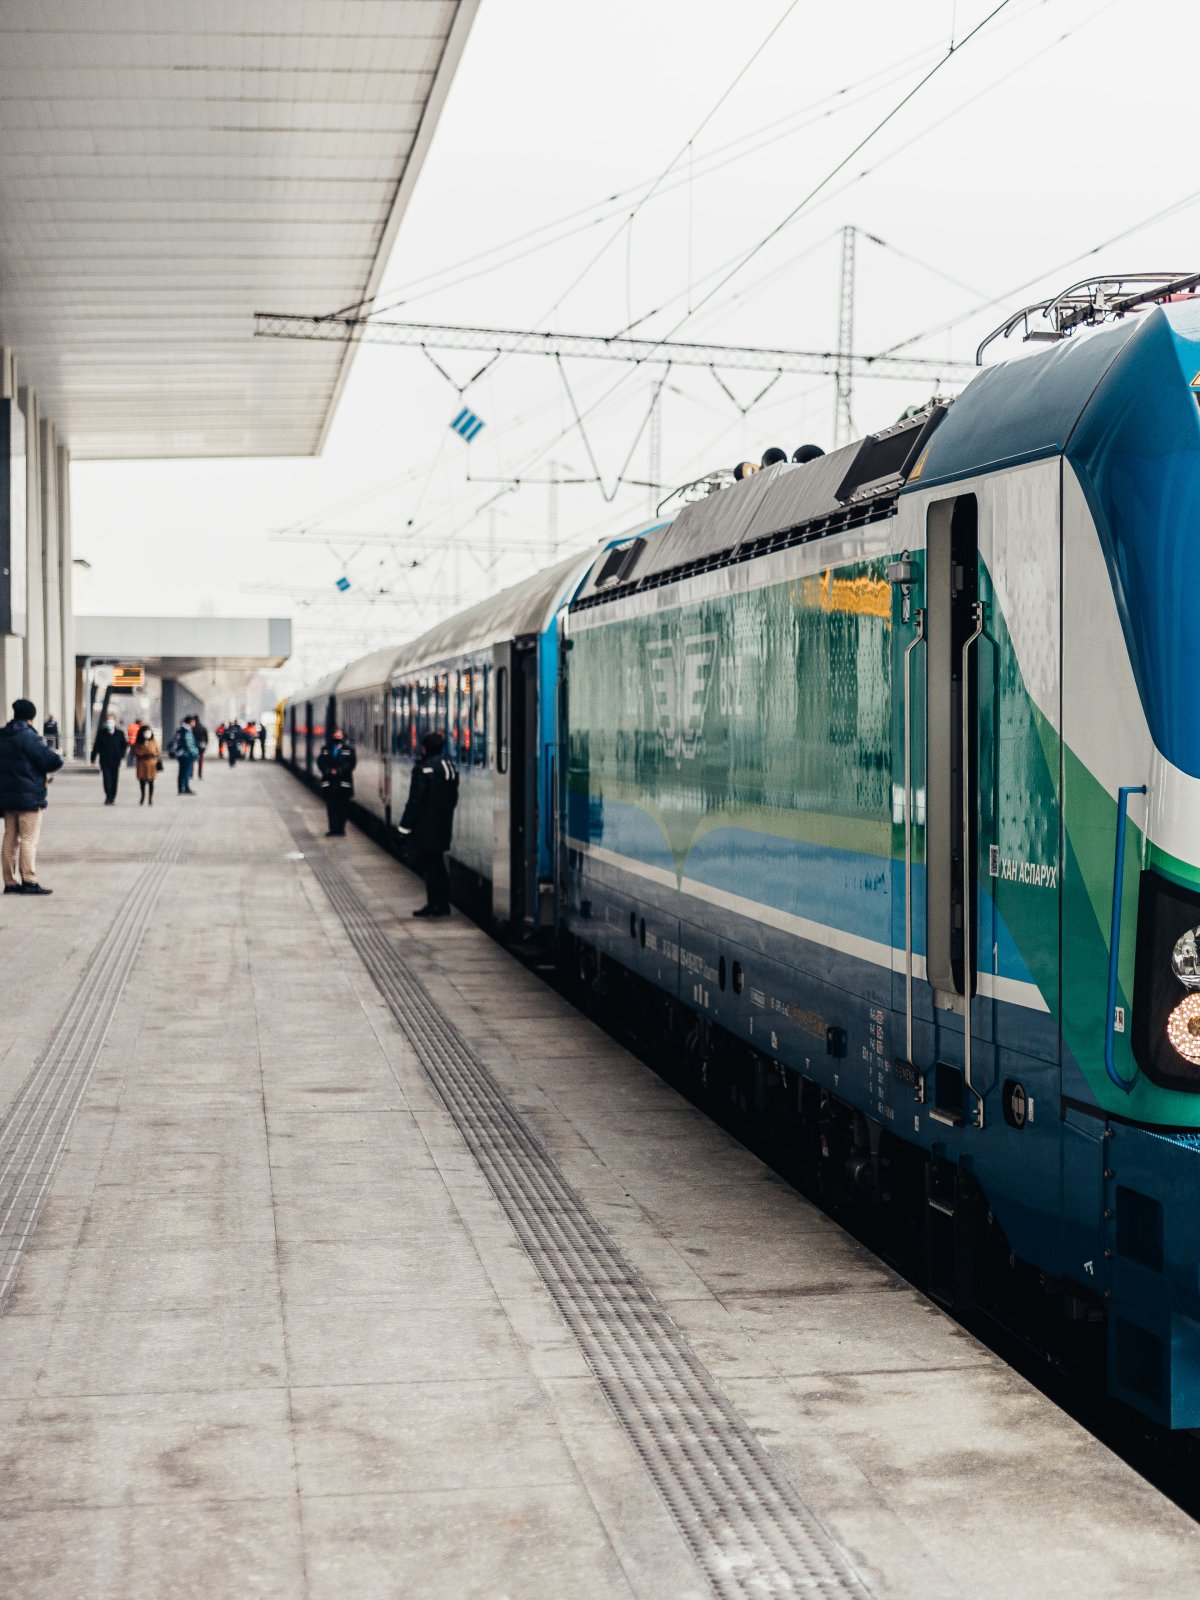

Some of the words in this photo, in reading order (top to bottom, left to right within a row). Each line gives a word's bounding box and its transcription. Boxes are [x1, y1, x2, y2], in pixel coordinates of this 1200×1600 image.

[1001, 858, 1018, 882] ХАН
[1019, 861, 1057, 889] АСПАРУХ
[992, 941, 998, 975] 1
